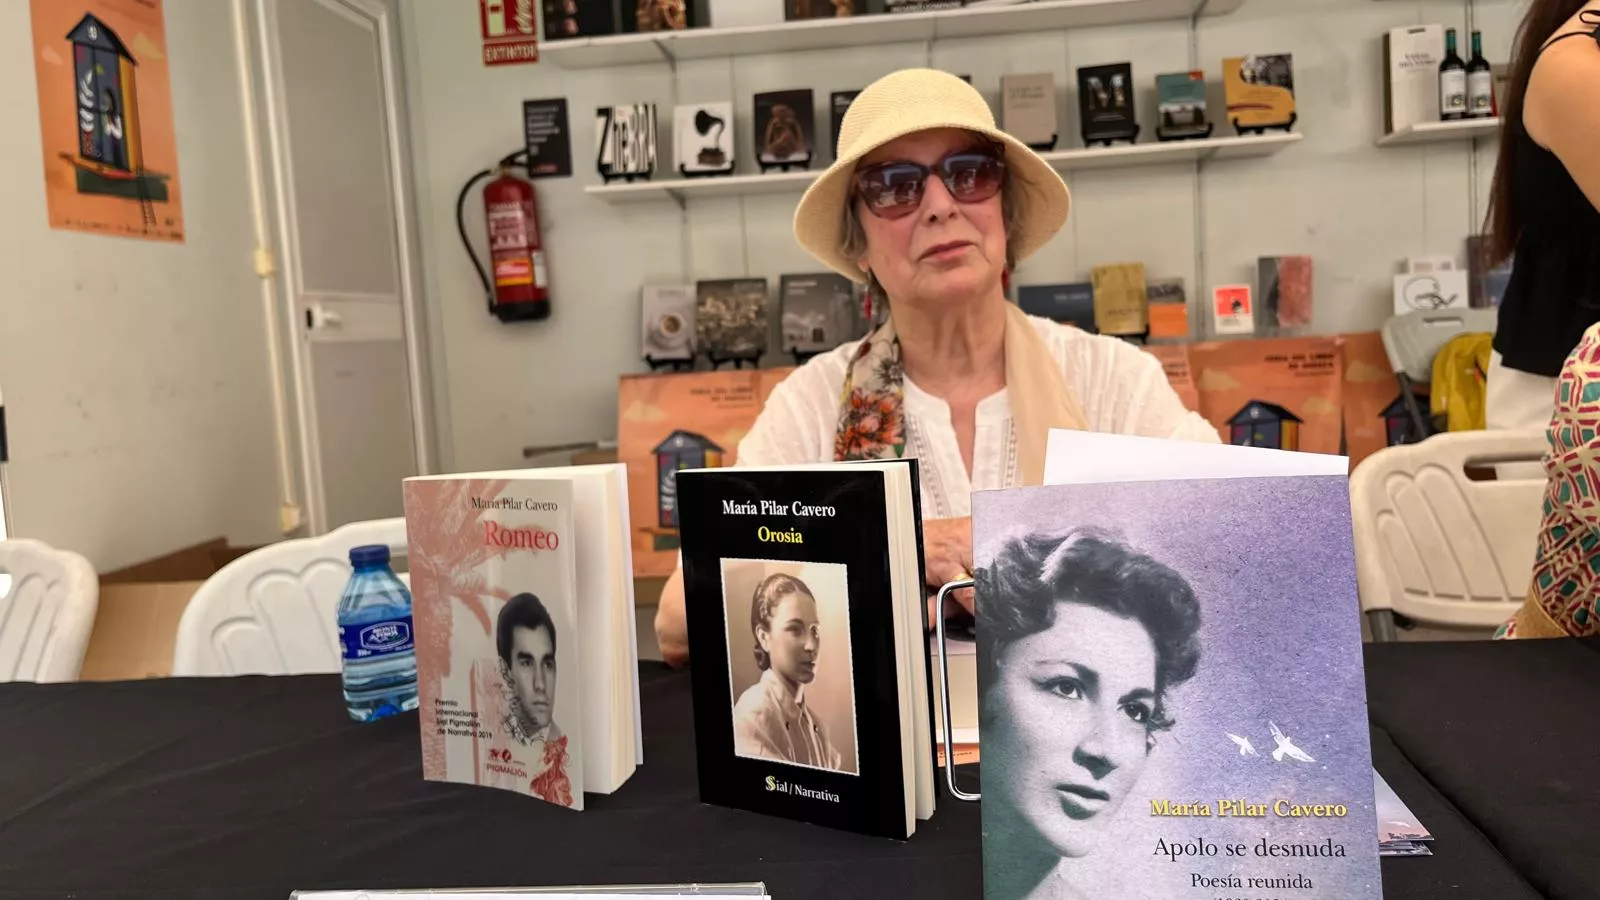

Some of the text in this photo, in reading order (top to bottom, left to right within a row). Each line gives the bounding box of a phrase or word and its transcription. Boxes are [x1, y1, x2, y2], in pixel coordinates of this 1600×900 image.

[502, 496, 523, 511] Pilar
[525, 498, 558, 511] Cavero
[722, 499, 836, 517] María Pilar Cavero
[483, 520, 559, 551] Romeo
[757, 525, 804, 543] Orosia
[434, 698, 458, 707] Premio
[447, 729, 478, 737] Narrativa
[765, 775, 788, 793] Sial
[794, 784, 840, 803] Narrativa
[1150, 799, 1348, 818] María Pilar Cavero
[1153, 837, 1347, 862] Apolo se desnuda
[1191, 872, 1313, 889] Poesía reunida
